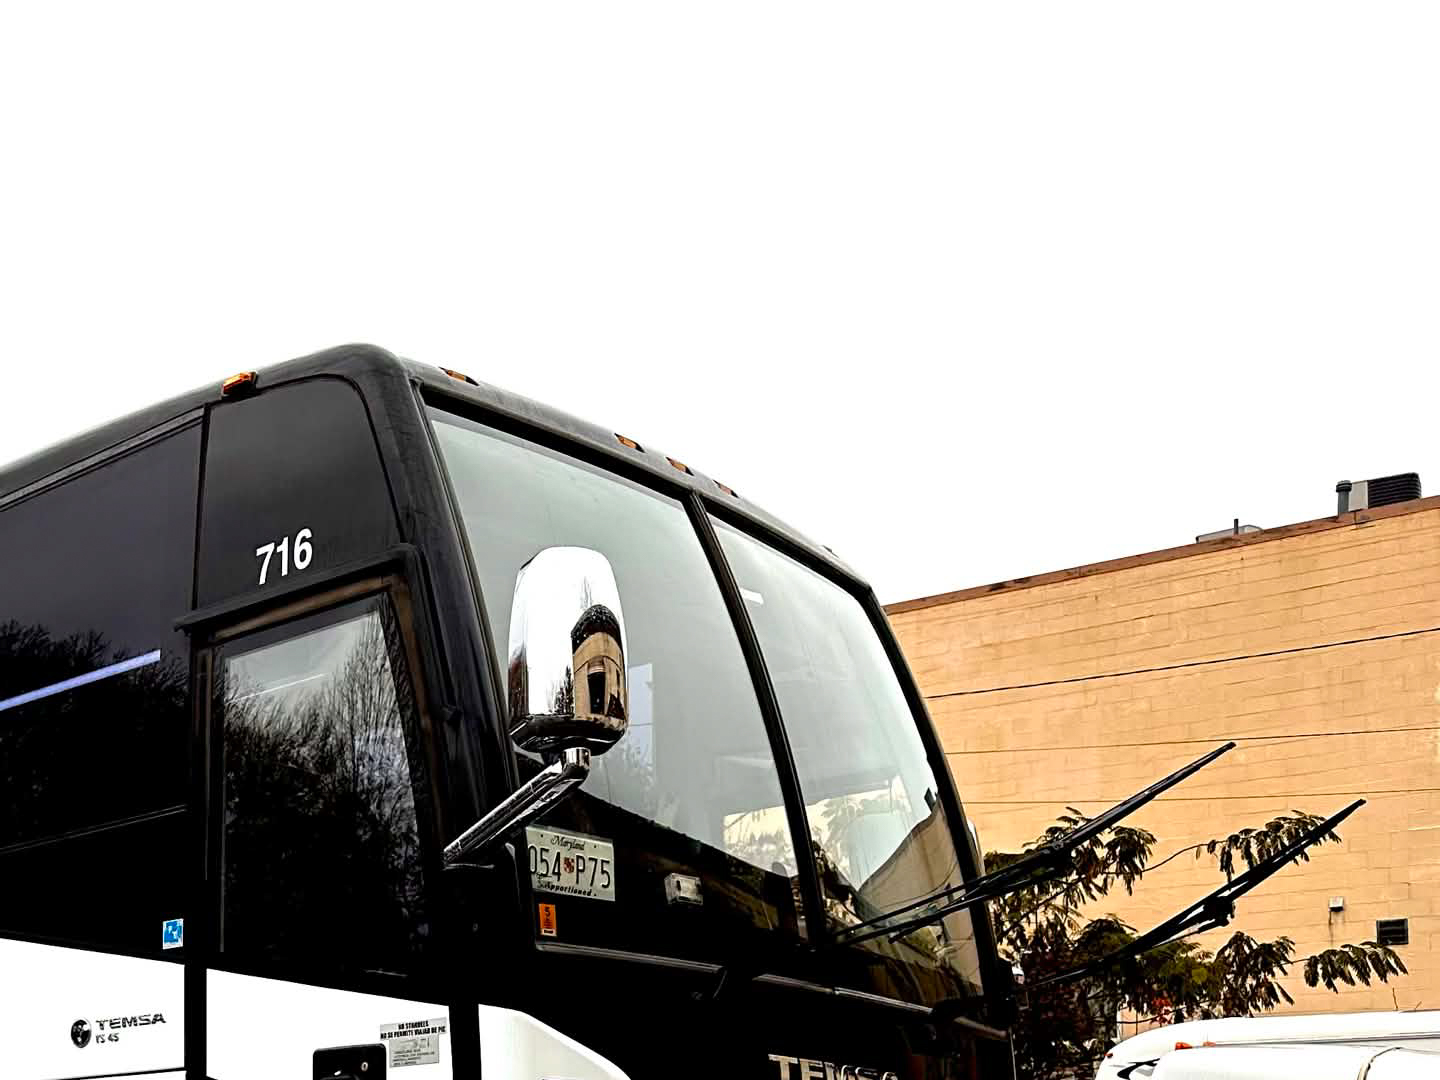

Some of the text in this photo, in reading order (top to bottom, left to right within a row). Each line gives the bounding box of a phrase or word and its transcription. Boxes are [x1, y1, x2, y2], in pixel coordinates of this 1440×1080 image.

[256, 528, 312, 585] 716
[551, 835, 585, 851] Maryland
[528, 845, 611, 888] 054 P75
[95, 1013, 166, 1030] TEMSA
[107, 1033, 119, 1042] 45
